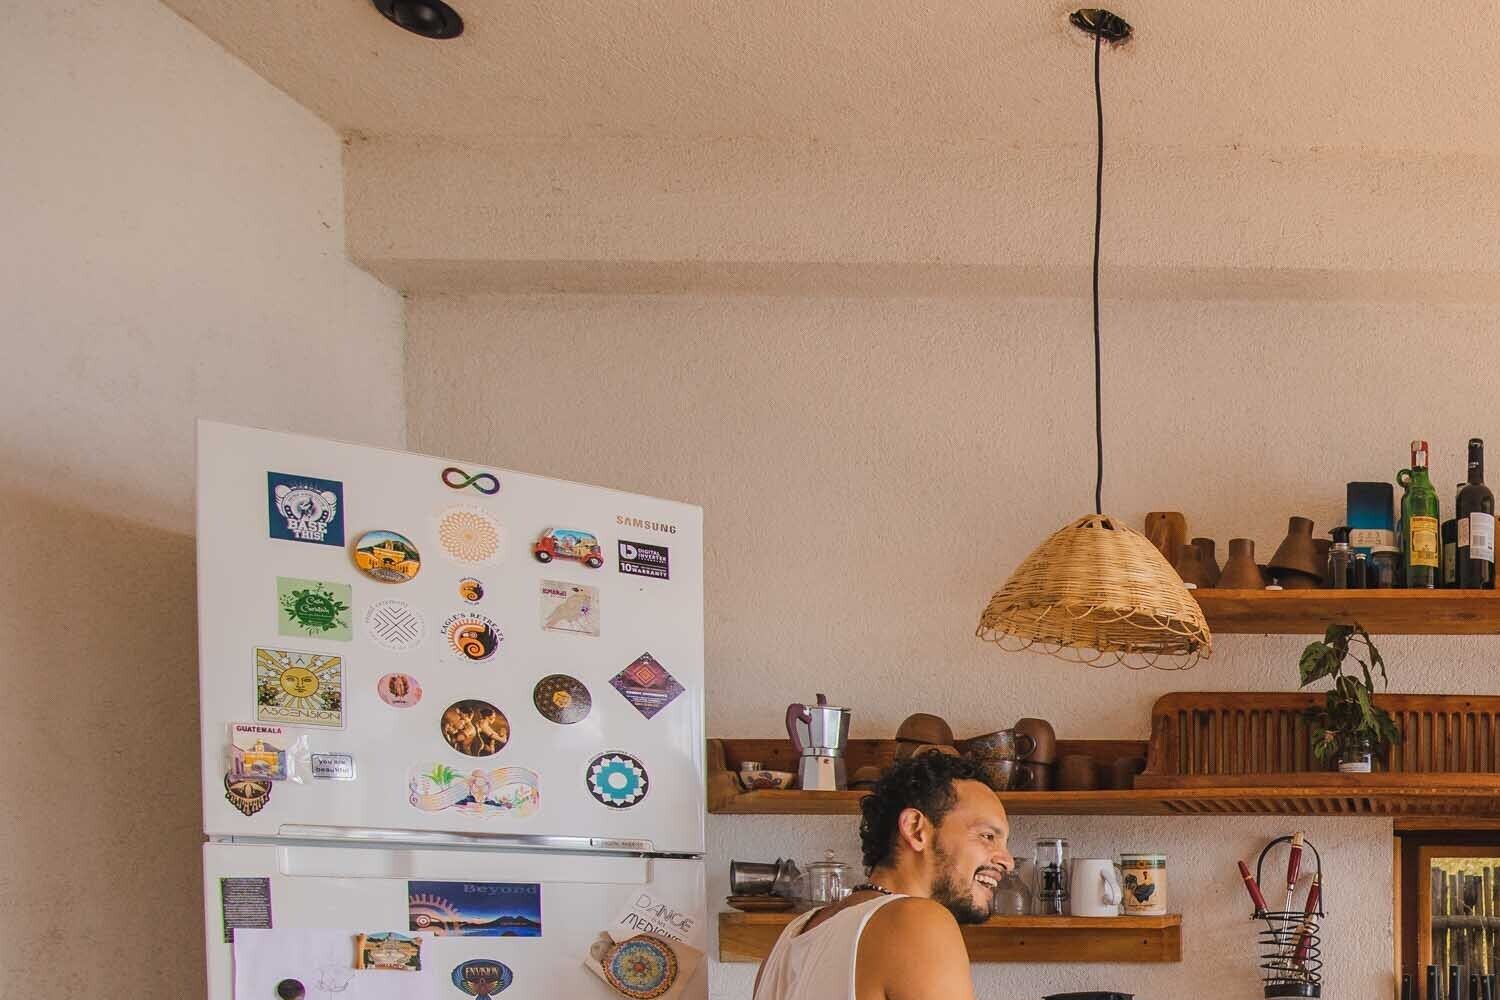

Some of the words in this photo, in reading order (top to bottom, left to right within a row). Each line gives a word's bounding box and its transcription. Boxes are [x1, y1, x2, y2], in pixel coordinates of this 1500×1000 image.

[287, 519, 328, 534] BASE
[616, 515, 677, 534] SAMSUNG
[293, 529, 325, 541] THIS!
[620, 562, 632, 572] 10
[631, 567, 668, 577] WARRANTY
[439, 612, 467, 635] EAGLE'S
[470, 612, 505, 642] RETREATS
[259, 706, 341, 721] ASCENSION
[235, 725, 283, 734] GUATEMALA
[463, 884, 537, 896] Beyond
[635, 894, 694, 933] DANCE
[464, 966, 499, 976] ENVISION
